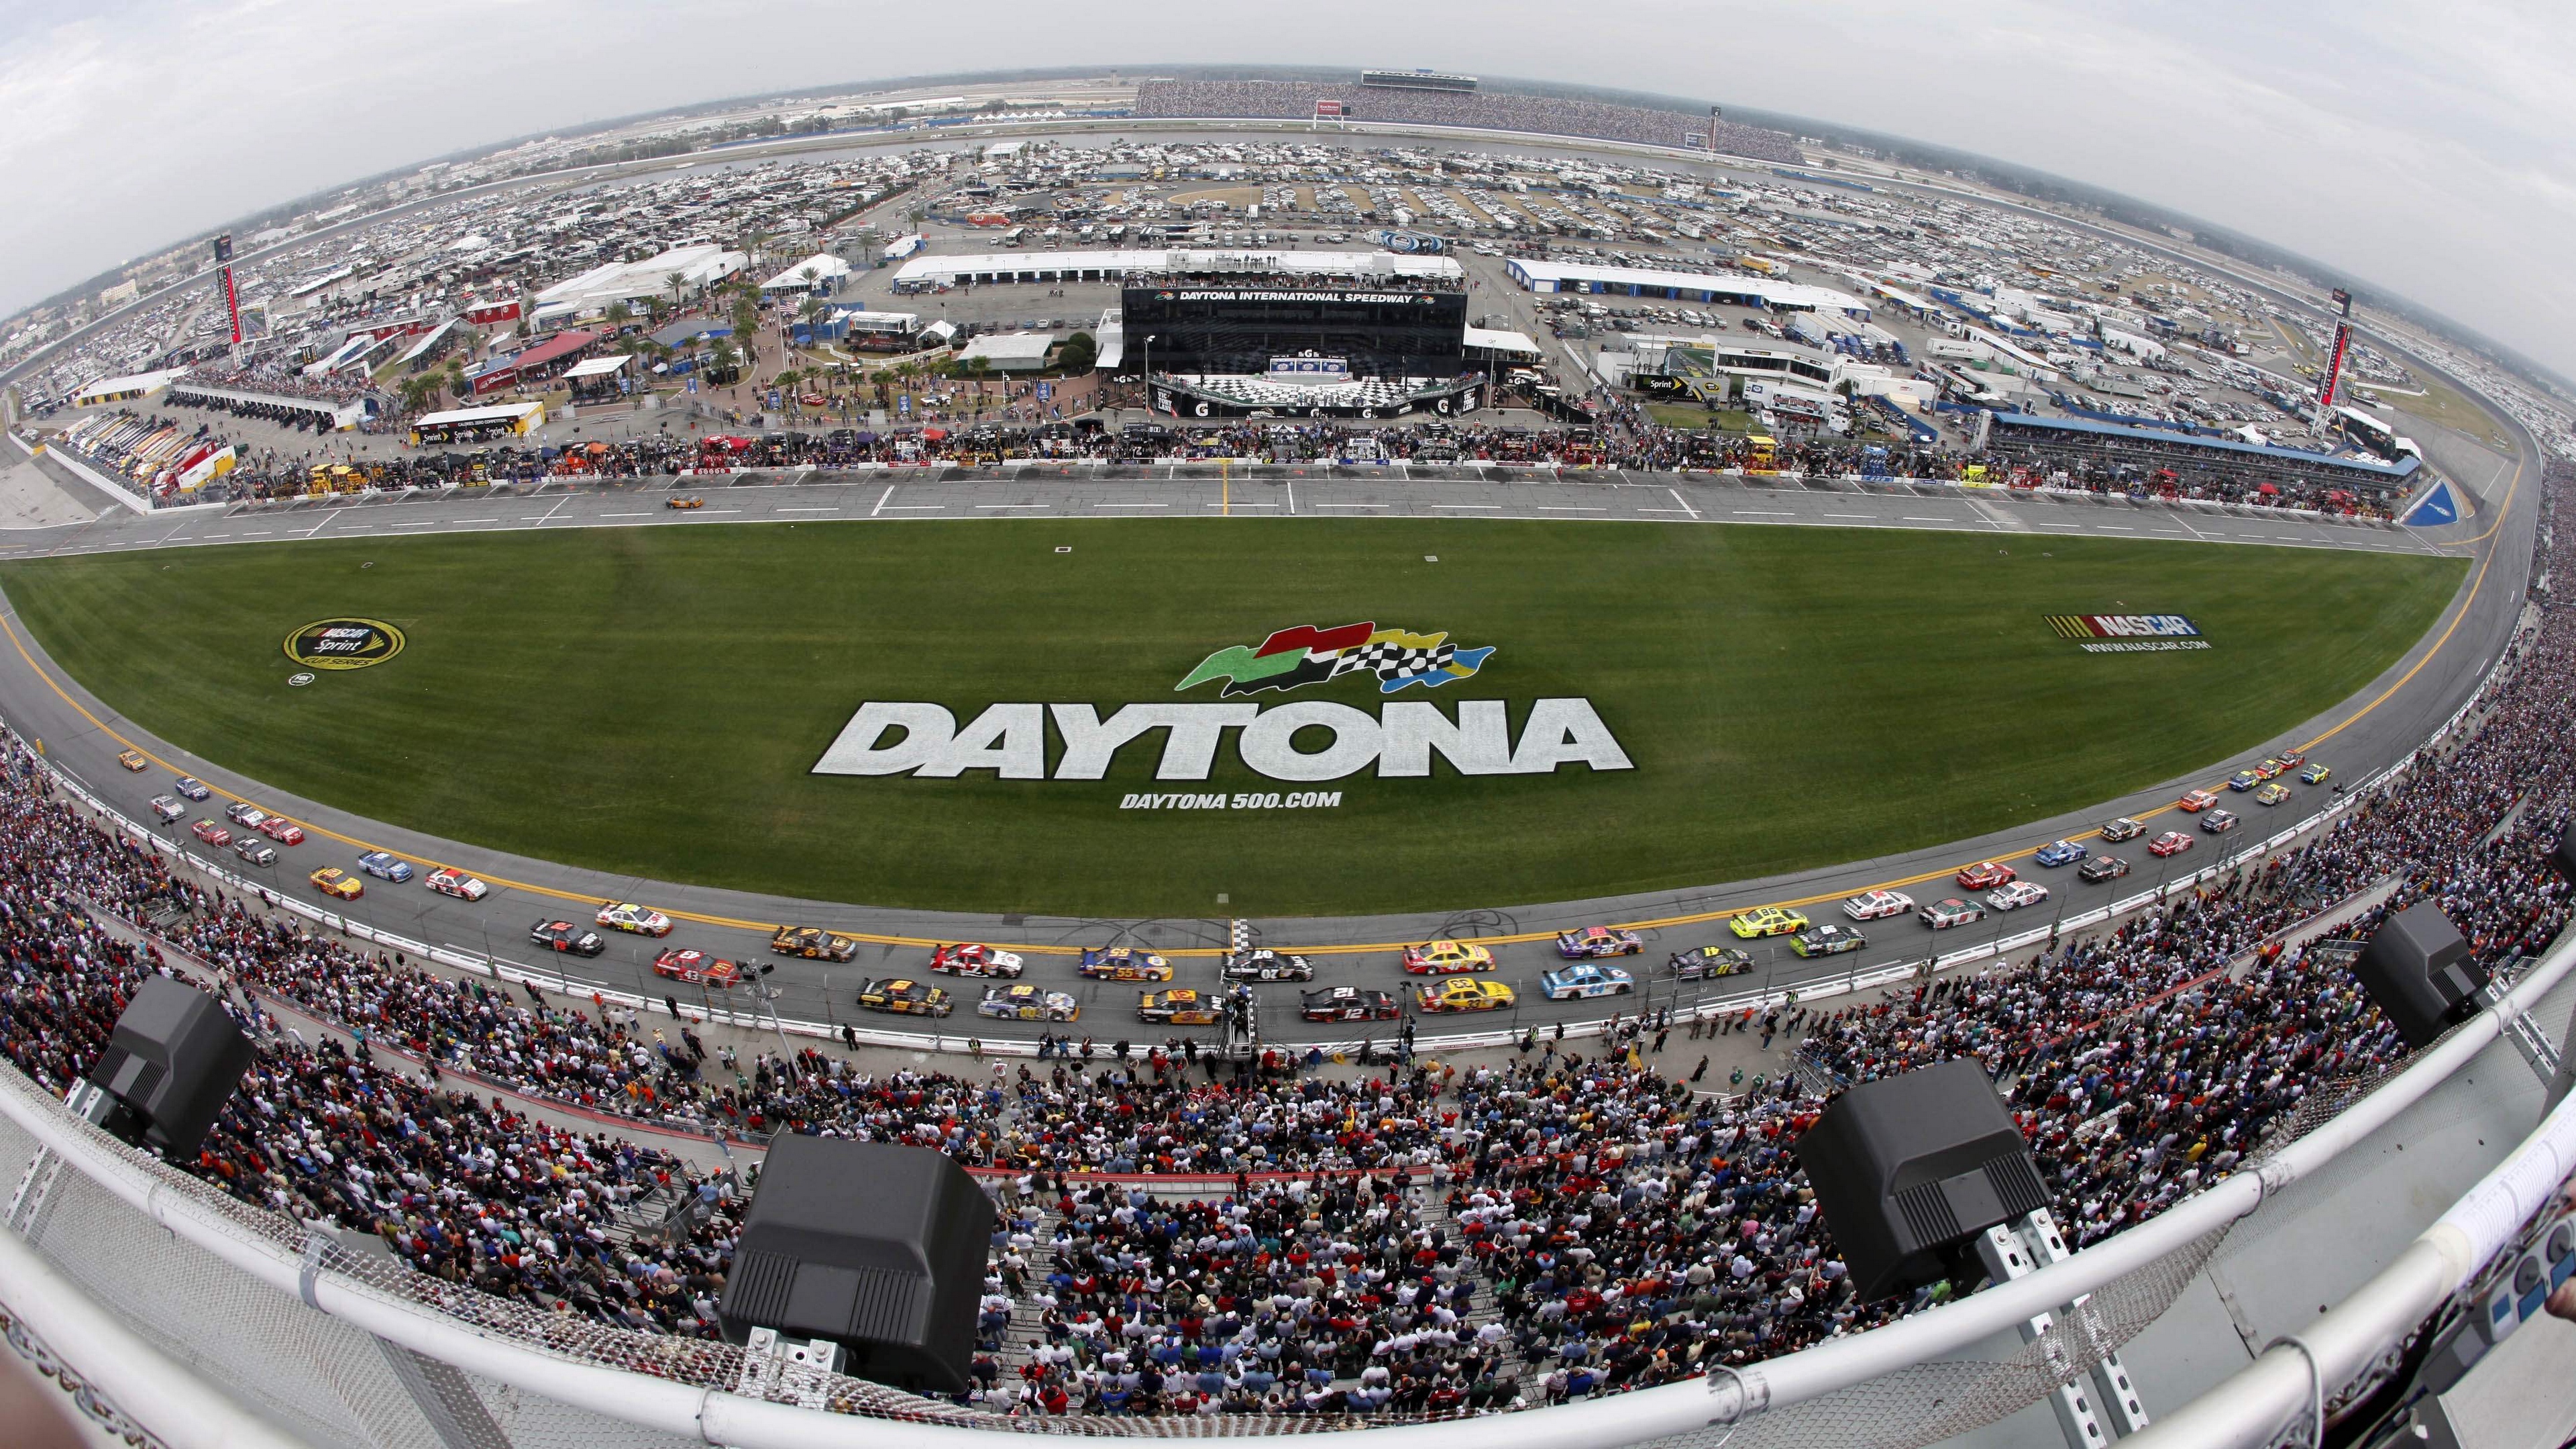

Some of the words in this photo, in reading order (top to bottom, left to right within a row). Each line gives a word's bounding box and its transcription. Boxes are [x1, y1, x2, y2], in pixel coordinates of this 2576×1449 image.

[1179, 291, 1236, 301] DAYTONA
[1239, 291, 1341, 302] INTERNATIONAL
[1344, 293, 1413, 304] SPEEDWAY
[1304, 349, 1312, 358] G
[1118, 375, 1126, 383] G
[1650, 379, 1672, 389] Sprint
[1157, 390, 1167, 399] VIC
[1158, 397, 1172, 406] TORY
[1438, 399, 1448, 413] G
[1158, 402, 1172, 413] LANE
[1195, 403, 1208, 417] G
[1310, 408, 1320, 418] G
[1362, 409, 1371, 419] G
[486, 427, 504, 436] Sprint
[424, 433, 441, 442] Sprint
[2093, 615, 2198, 637] NASCAR
[322, 629, 369, 638] NASCAR
[314, 639, 363, 653] Sprint
[2080, 640, 2212, 653] WWW.NASCAR.COM
[812, 698, 1635, 780] DAYTONA
[1120, 793, 1227, 810] DAYTONA
[1230, 791, 1342, 809] 500.COM
[648, 913, 663, 924] 3M
[623, 922, 635, 930] 16
[804, 948, 817, 957] 6
[1599, 945, 1616, 955] 26
[969, 963, 982, 975] 7
[1447, 961, 1462, 971] 47
[684, 970, 699, 981] 43
[1116, 967, 1134, 977] 55
[1260, 969, 1279, 979] 07
[1588, 984, 1605, 995] 44
[1465, 999, 1481, 1009] 33
[1019, 1006, 1037, 1018] 00
[1183, 1012, 1197, 1021] 31
[1344, 1008, 1364, 1019] 12
